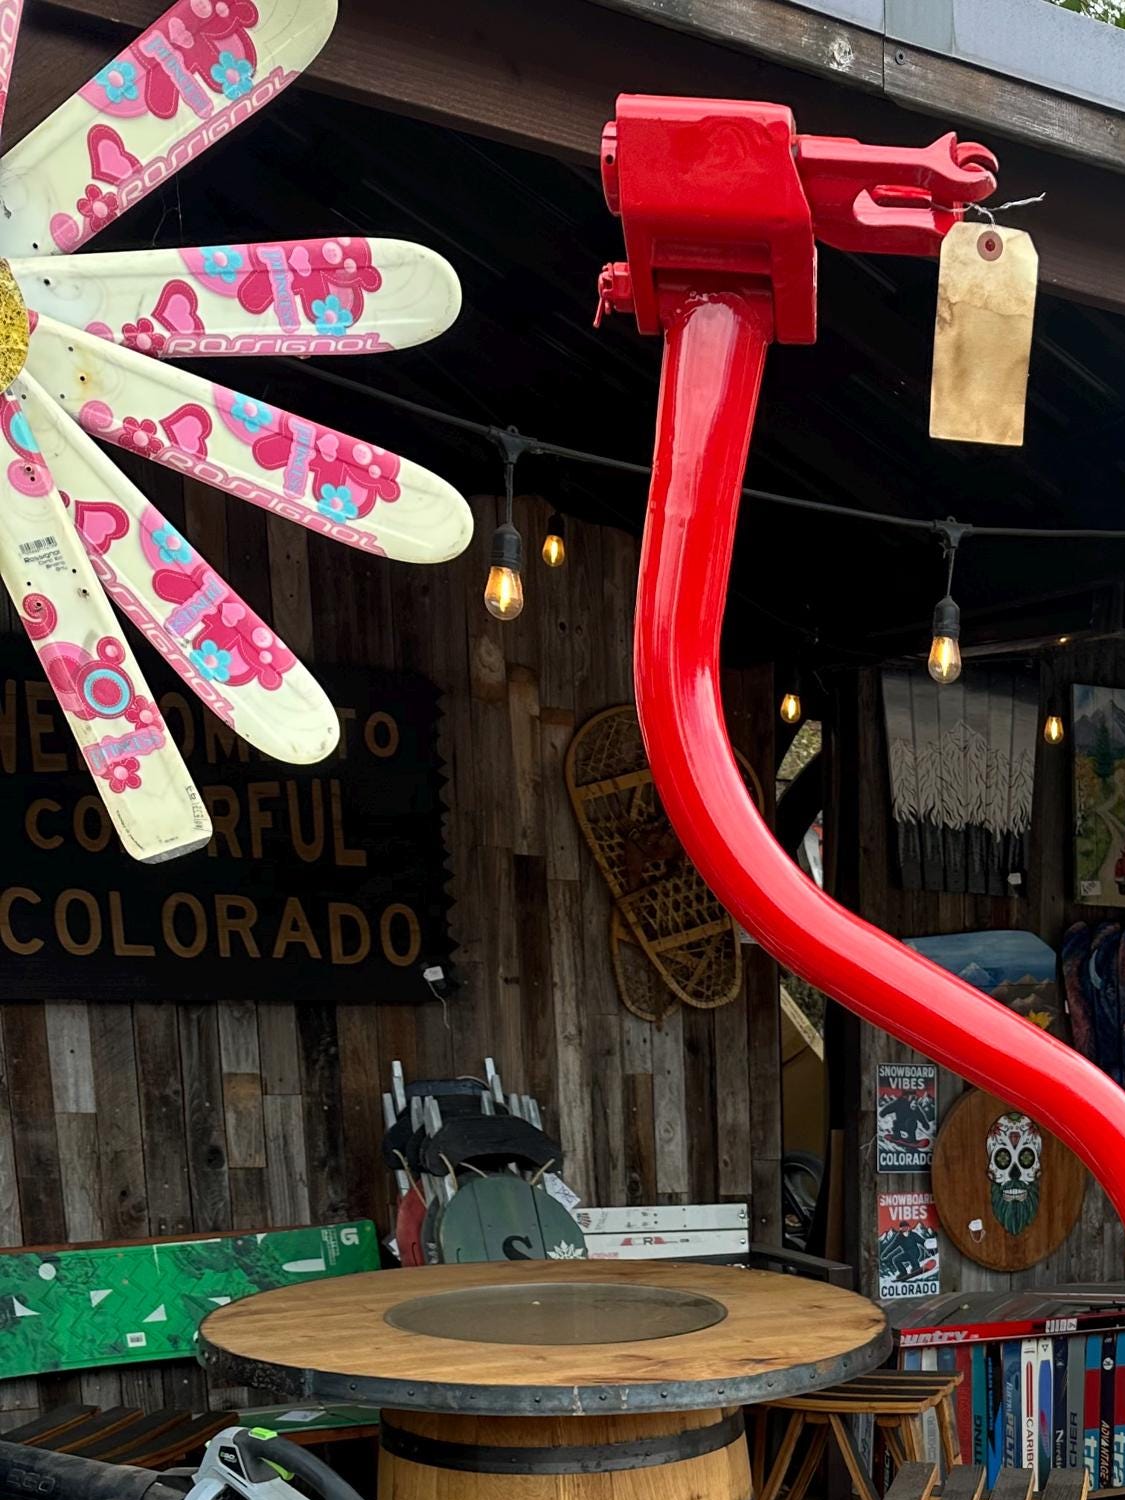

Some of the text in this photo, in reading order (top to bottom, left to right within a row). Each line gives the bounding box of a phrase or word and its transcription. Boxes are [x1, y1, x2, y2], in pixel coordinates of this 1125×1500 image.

[119, 72, 296, 206] ROSSIGNOL
[168, 335, 388, 353] ROSSIGNOL
[161, 450, 381, 552] ROSSIGNOL
[25, 777, 368, 868] CORFUL
[0, 885, 421, 967] COLORADO
[879, 1065, 934, 1078] SNOWBOARD
[889, 1077, 925, 1090] VIBES
[889, 1205, 928, 1220] VIBES
[881, 1282, 937, 1298] COLORADO
